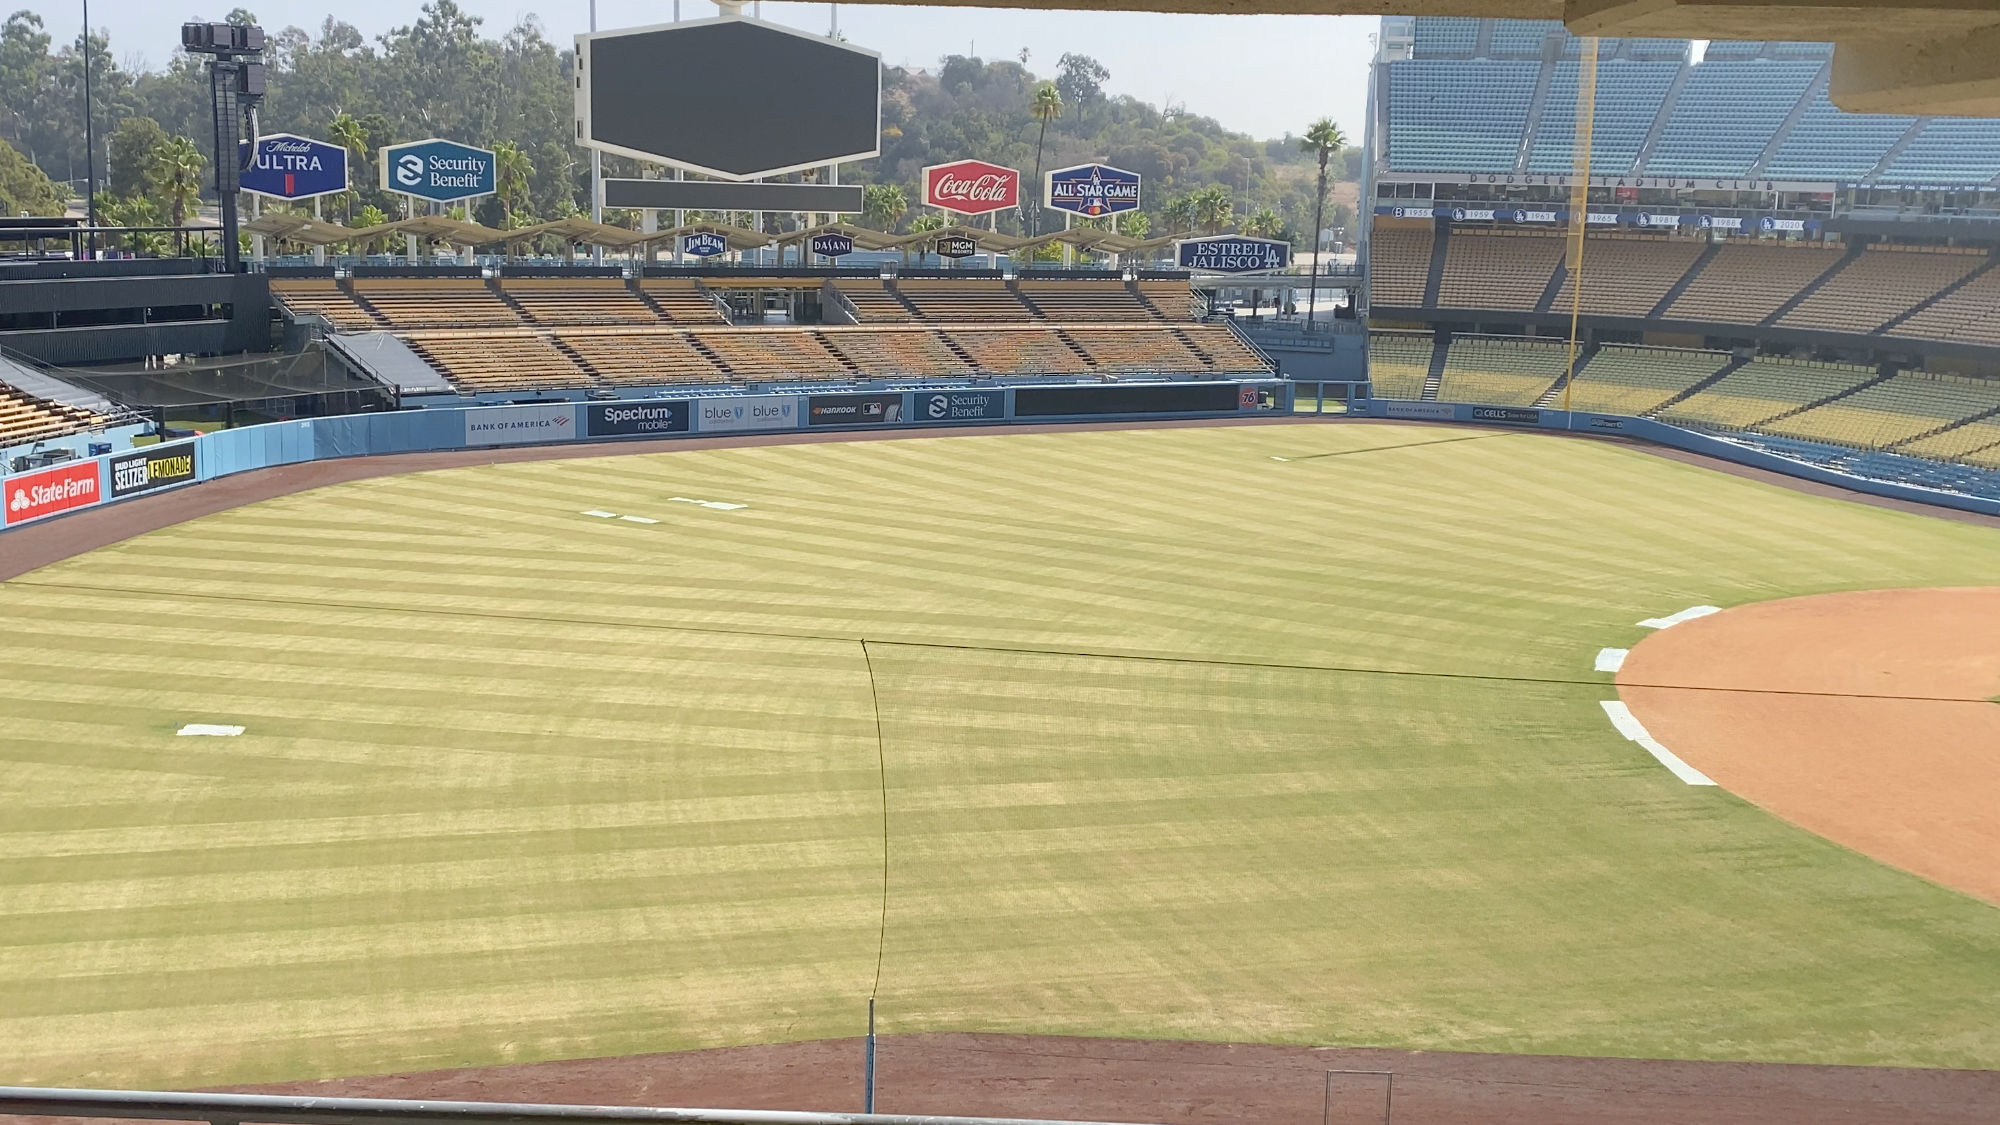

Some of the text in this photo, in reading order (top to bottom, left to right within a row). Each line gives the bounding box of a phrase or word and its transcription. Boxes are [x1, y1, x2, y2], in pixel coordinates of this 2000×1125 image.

[266, 141, 312, 153] Michelob
[257, 154, 322, 171] ULTRA
[429, 155, 487, 175] Security
[430, 172, 479, 188] Benefit
[1470, 174, 1565, 185] DODGER
[1716, 180, 1774, 191] CLUB
[934, 173, 1012, 201] Coca-Cola
[1104, 184, 1137, 198] GAME
[1531, 211, 1550, 219] 1963
[1780, 221, 1800, 229] 2020
[686, 237, 701, 252] JIM
[702, 234, 724, 252] BEAM
[814, 240, 850, 252] DASANI
[952, 241, 973, 250] MGM
[1188, 256, 1260, 268] JALISCO
[951, 394, 989, 407] Security
[1242, 391, 1256, 403] 76
[604, 406, 668, 424] Spectrum
[704, 407, 731, 419] blue
[753, 405, 779, 417] blue
[951, 405, 984, 417] Benefit
[1484, 409, 1506, 418] CELLS
[471, 420, 550, 431] BANK OF AMERICA
[637, 420, 668, 430] mobile
[114, 457, 147, 471] BUD LIGHT
[148, 455, 191, 479] LEMONADE
[114, 465, 149, 491] SELTZER
